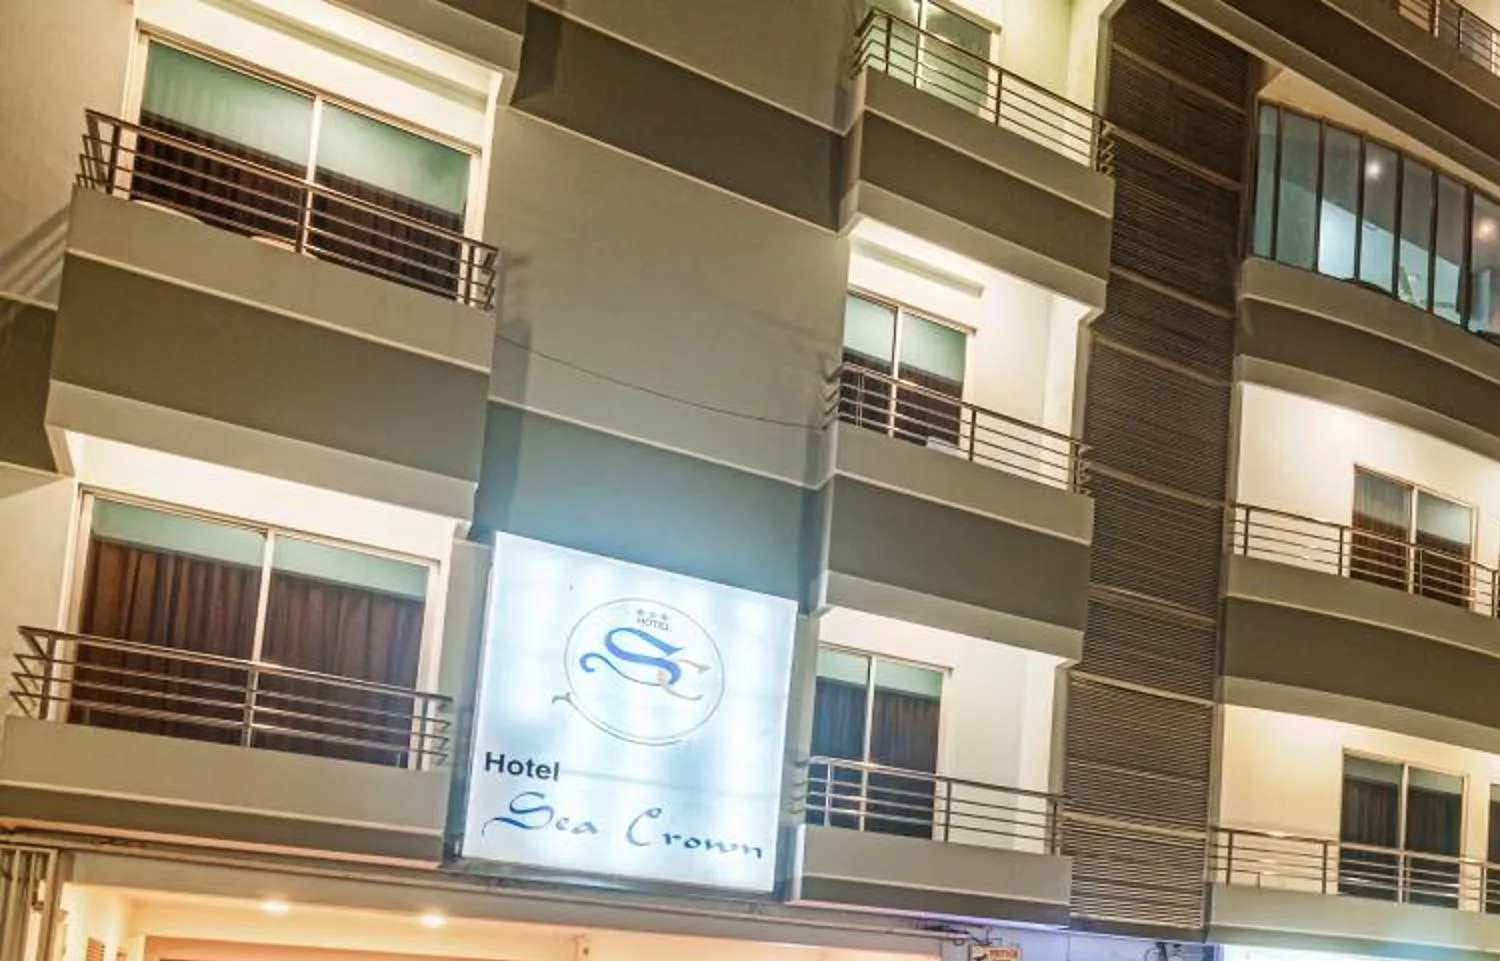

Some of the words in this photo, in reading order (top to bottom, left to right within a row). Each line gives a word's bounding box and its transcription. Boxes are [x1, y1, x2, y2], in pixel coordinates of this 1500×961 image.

[484, 751, 560, 782] Hotel
[481, 792, 599, 836] Sea
[625, 807, 763, 860] Crown
